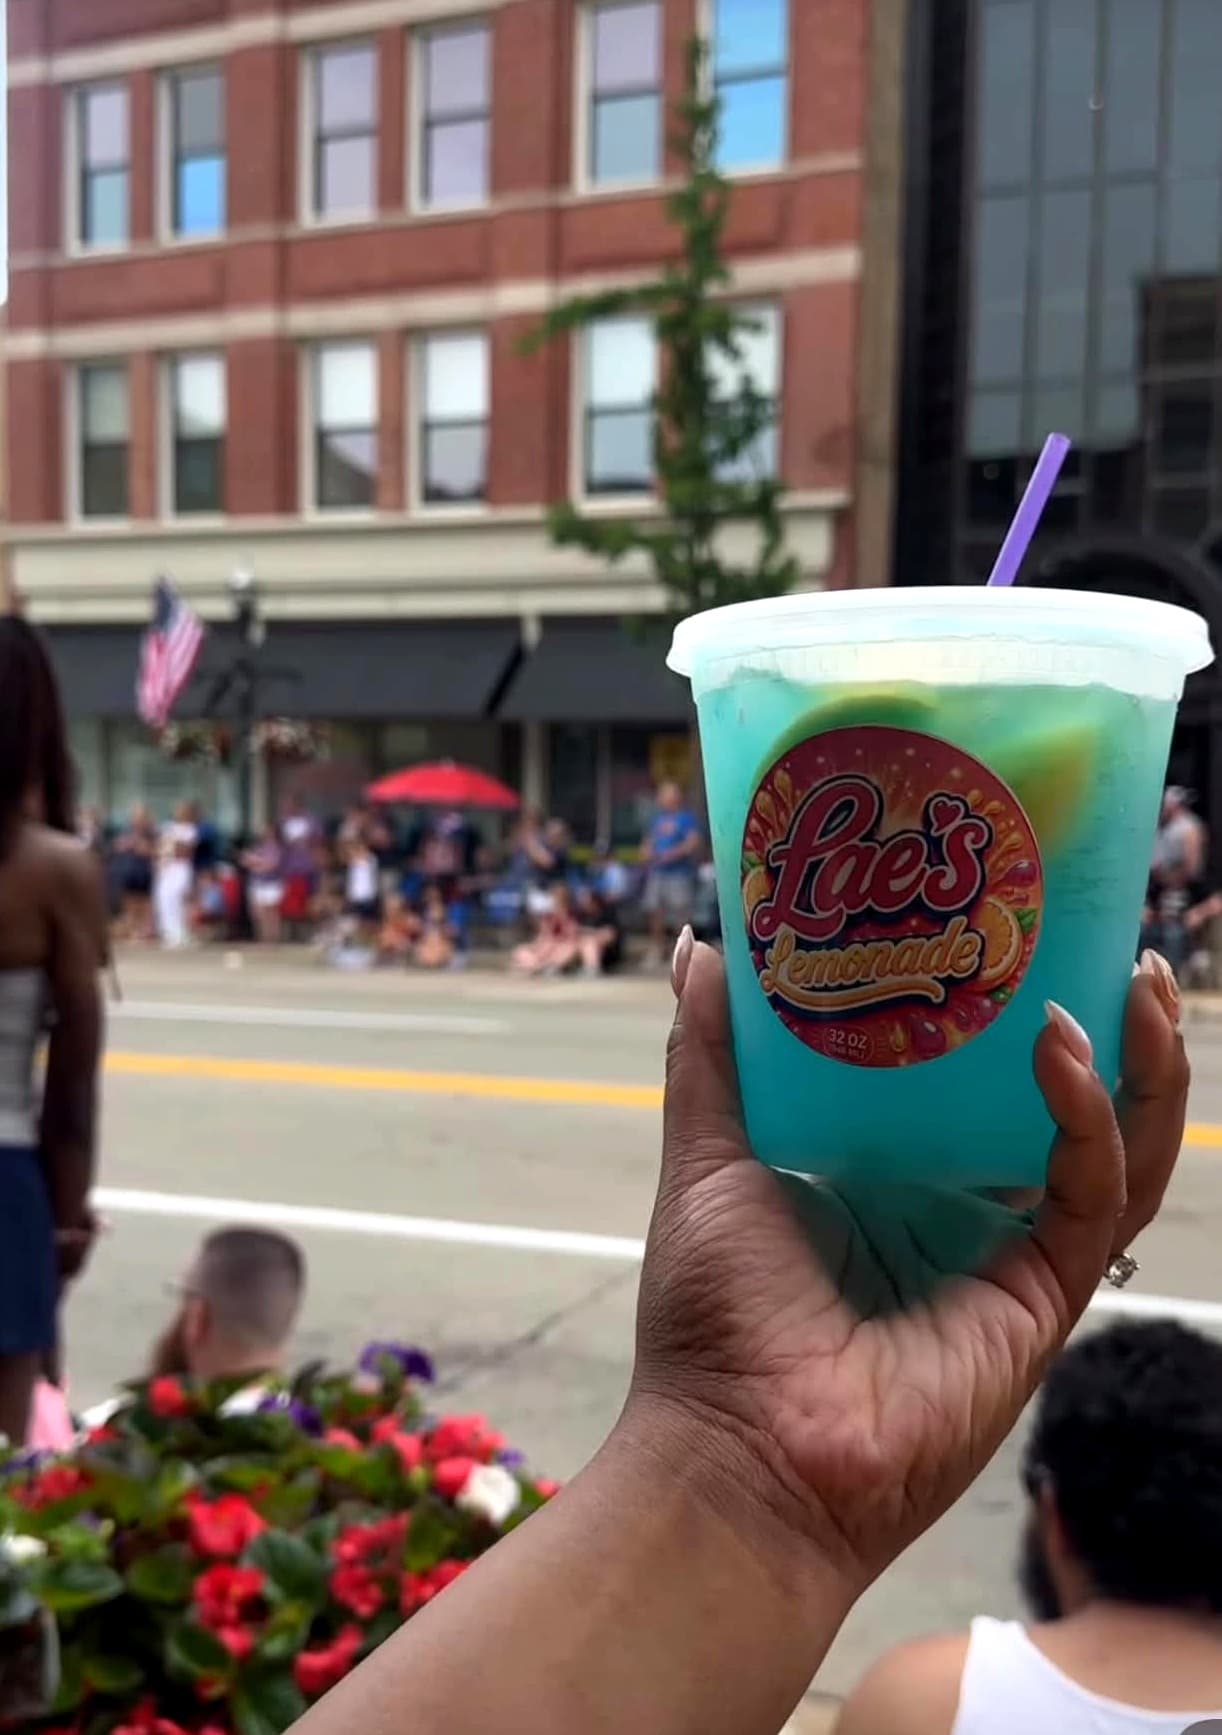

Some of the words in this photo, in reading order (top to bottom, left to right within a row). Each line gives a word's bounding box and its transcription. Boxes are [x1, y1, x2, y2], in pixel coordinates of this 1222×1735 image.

[760, 916, 981, 1008] Lemonade
[829, 1028, 845, 1044] 32
[848, 1033, 868, 1049] OZ
